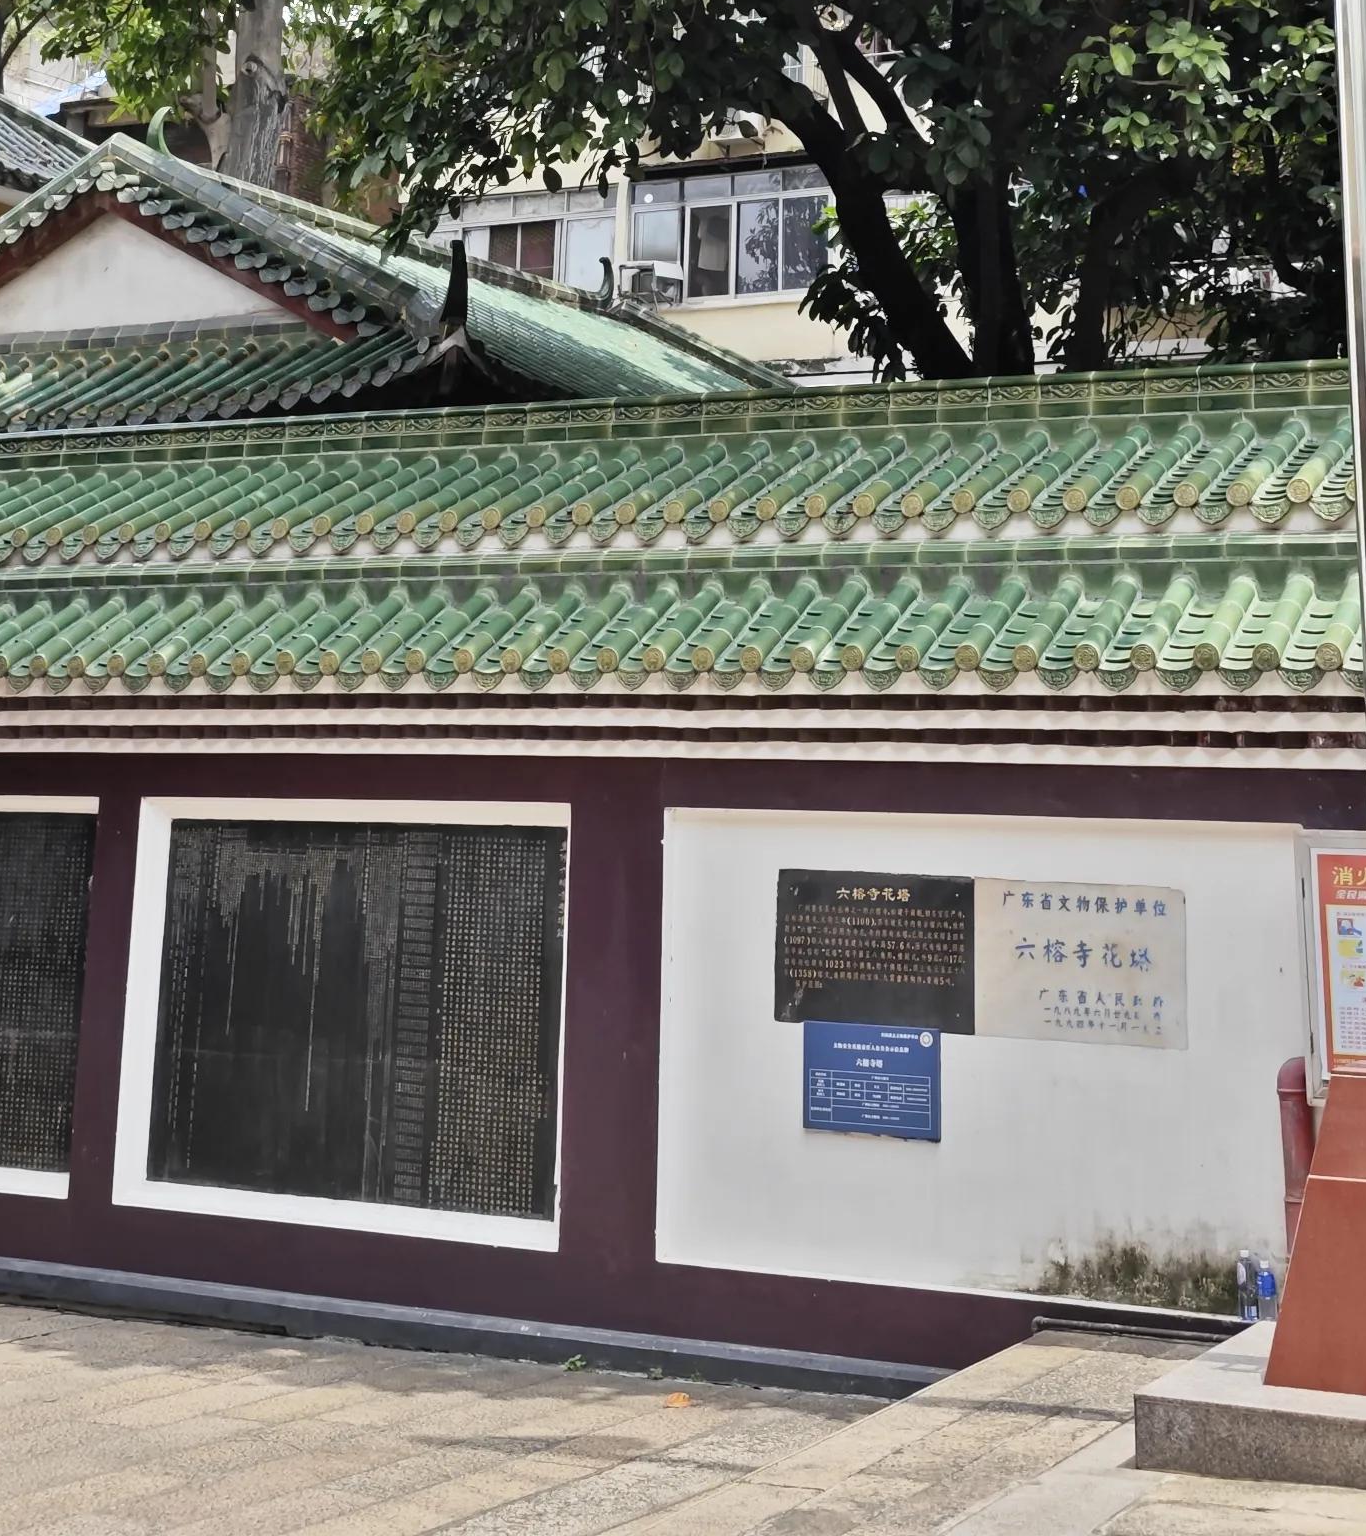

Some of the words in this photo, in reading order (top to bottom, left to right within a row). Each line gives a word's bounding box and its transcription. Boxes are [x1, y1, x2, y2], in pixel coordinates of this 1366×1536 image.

[836, 887, 911, 902] 六榕寺花塔
[1002, 890, 1167, 917] 广东省文物保护单位
[1014, 937, 1153, 973] 六榕寺花塔
